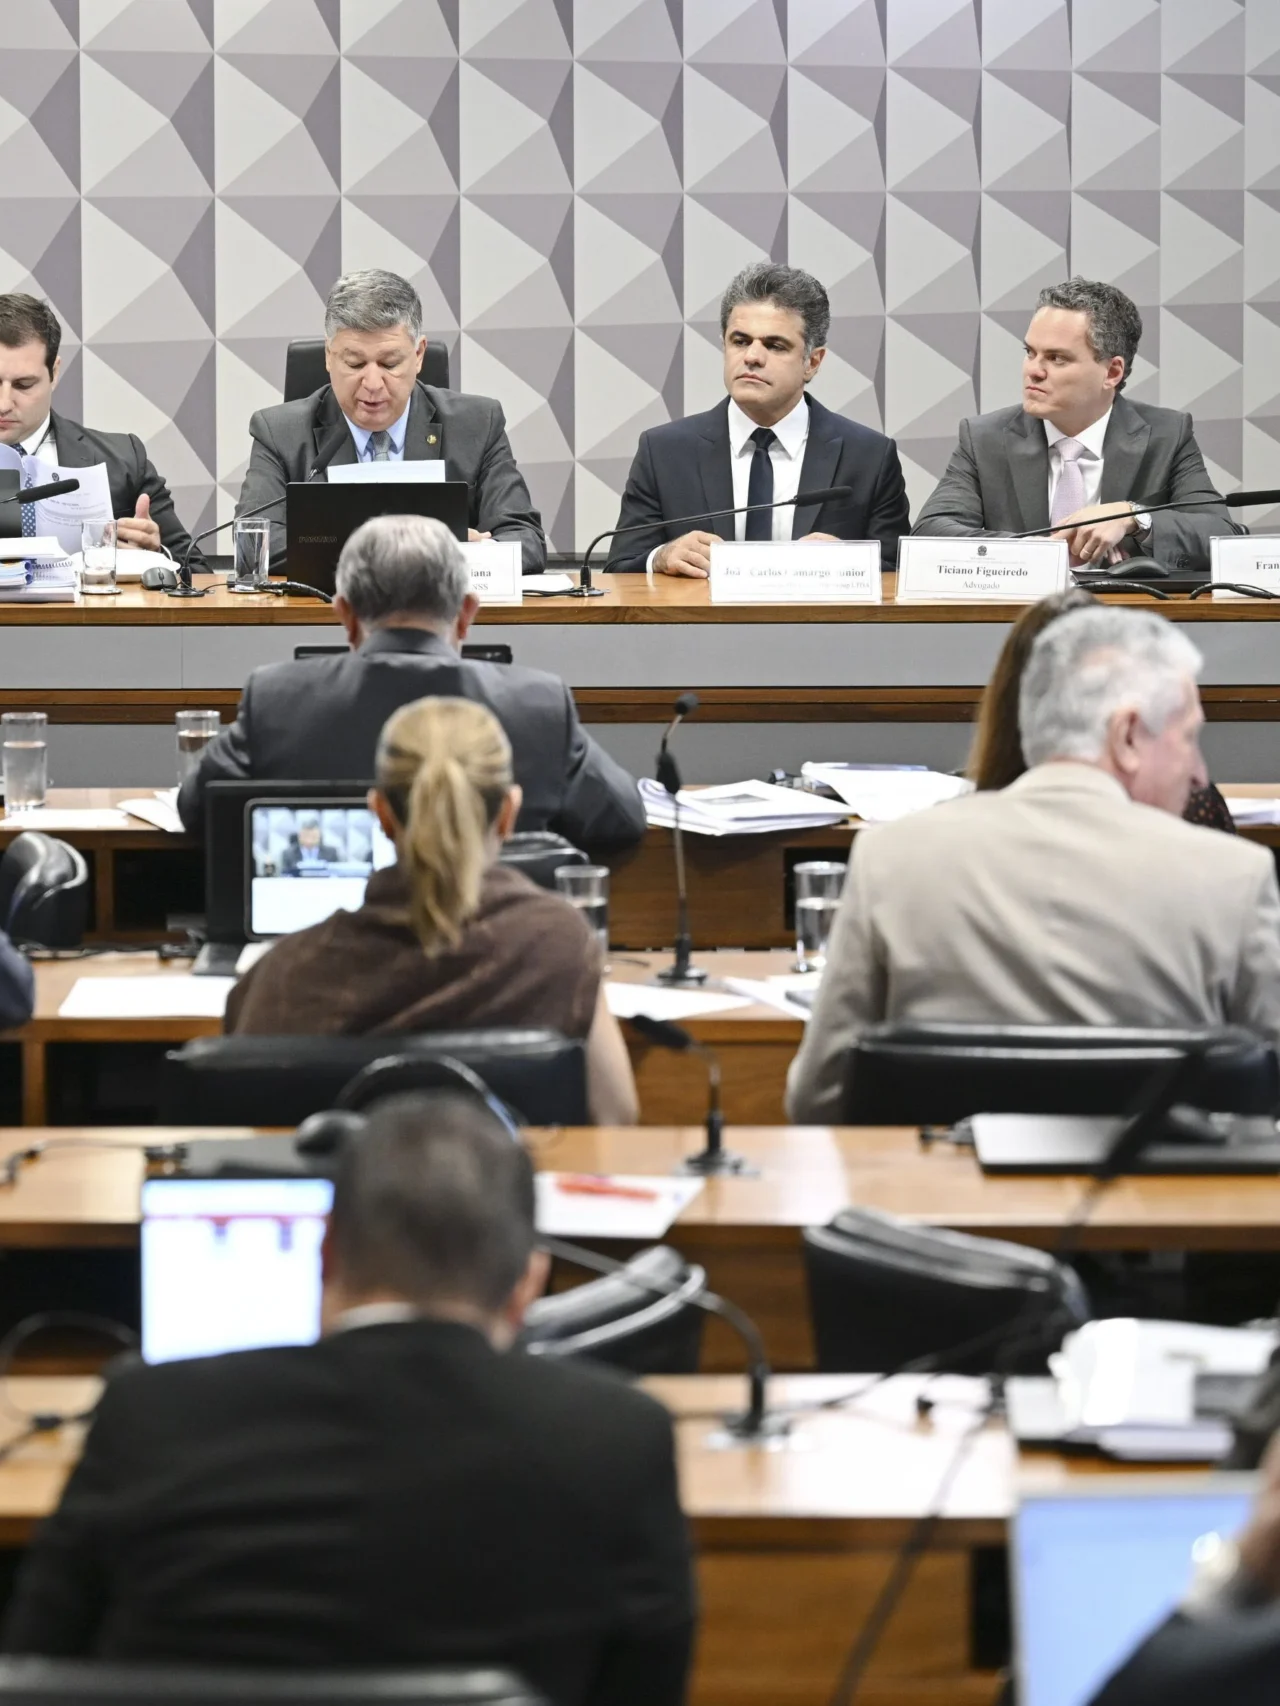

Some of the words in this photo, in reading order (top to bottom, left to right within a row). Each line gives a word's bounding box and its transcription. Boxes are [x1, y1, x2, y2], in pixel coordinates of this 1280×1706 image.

[471, 569, 491, 577] iana
[749, 567, 782, 577] Carlos
[937, 565, 973, 575] Ticiano
[976, 566, 1028, 577] Figueiredo
[962, 581, 1001, 590] Advogado
